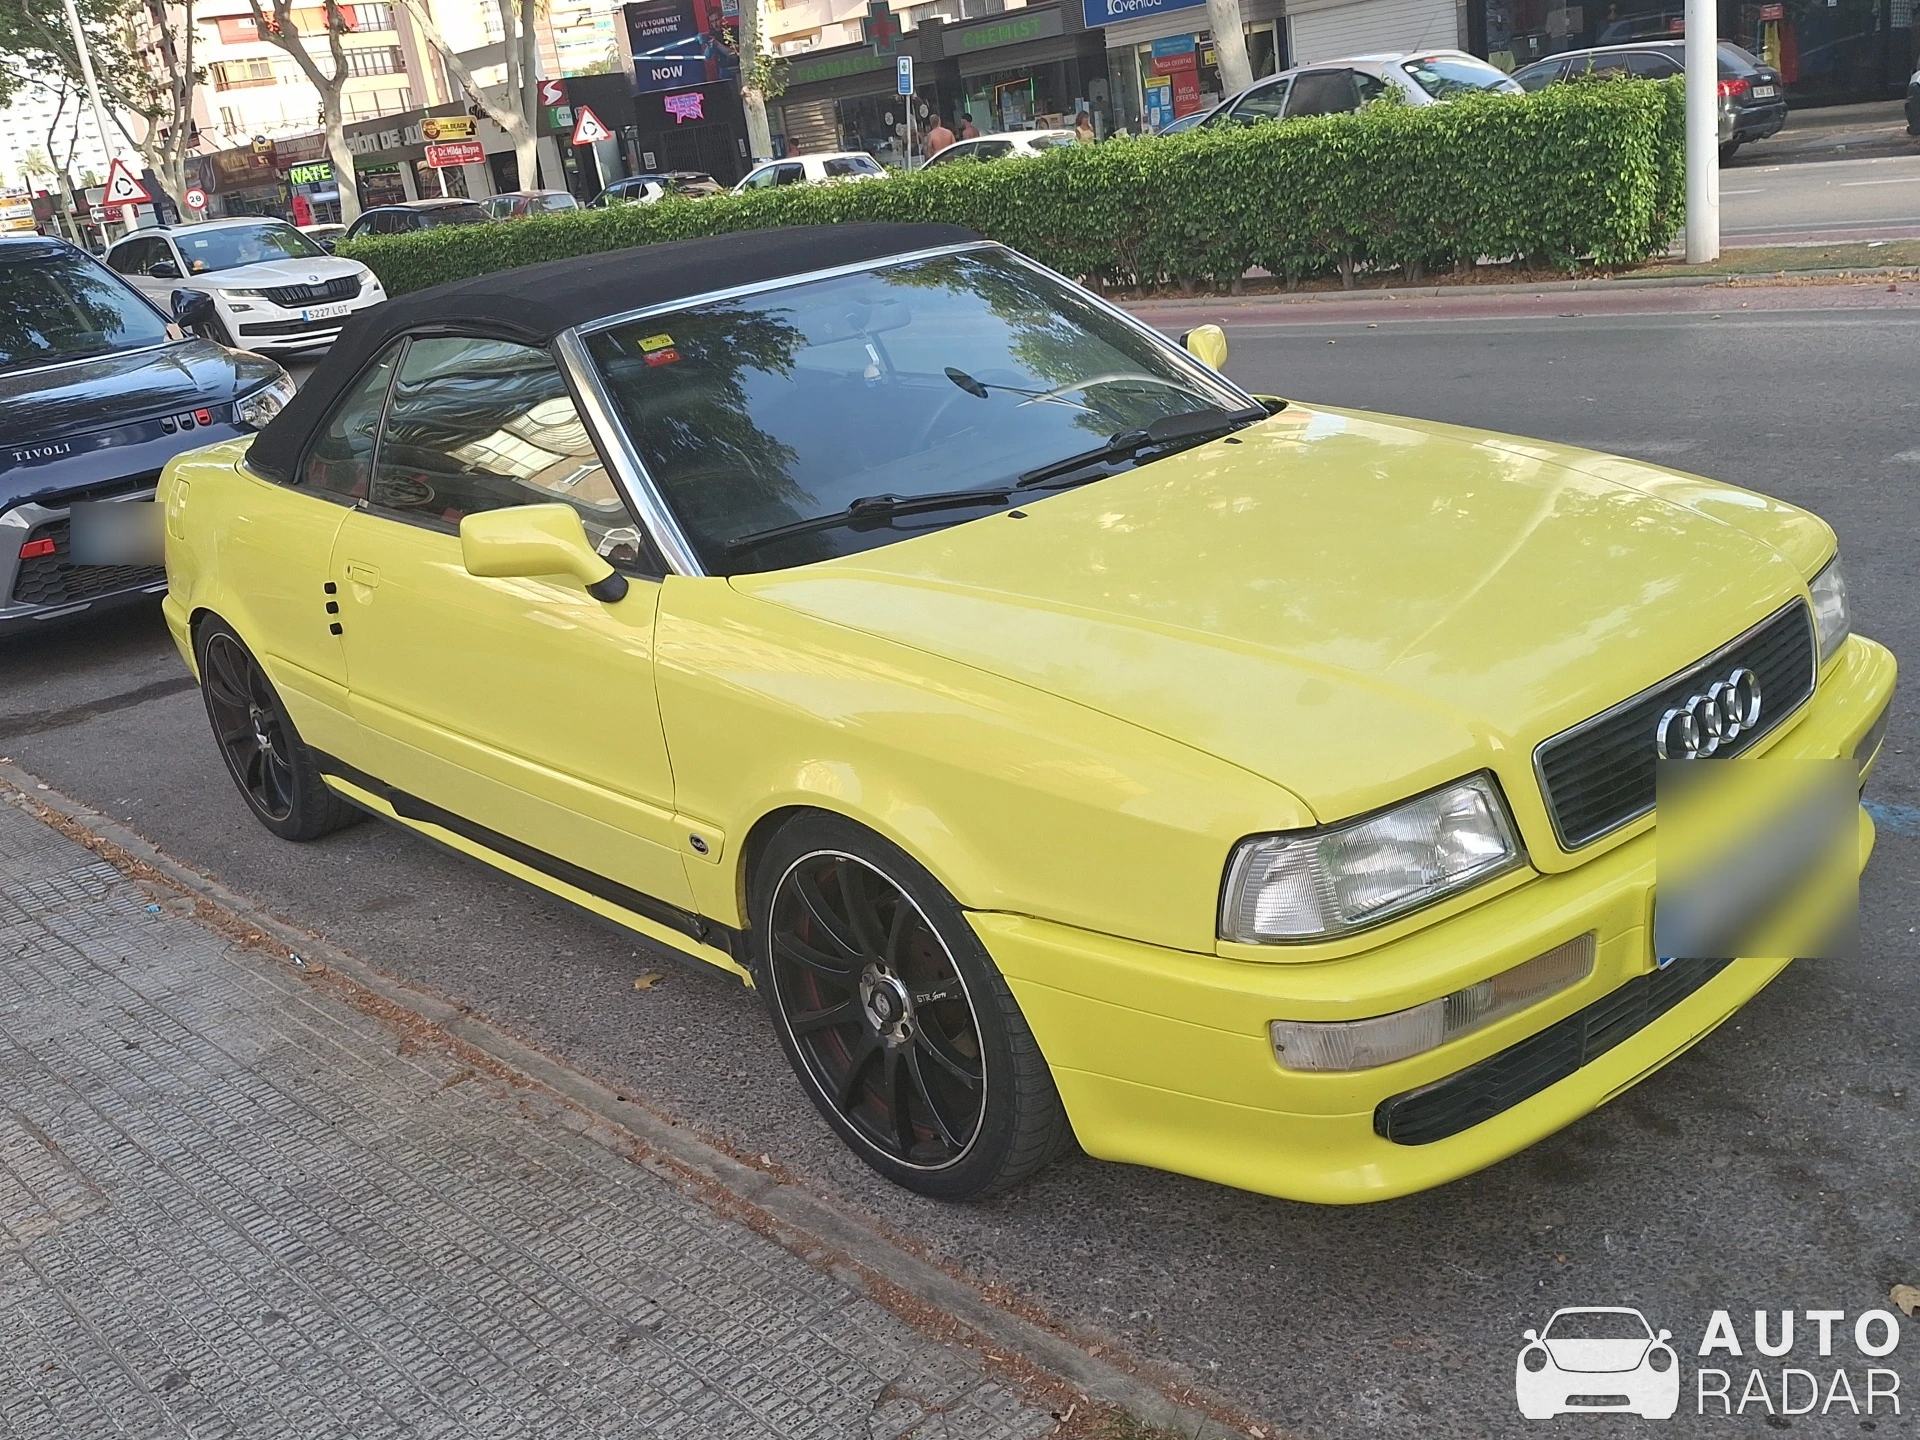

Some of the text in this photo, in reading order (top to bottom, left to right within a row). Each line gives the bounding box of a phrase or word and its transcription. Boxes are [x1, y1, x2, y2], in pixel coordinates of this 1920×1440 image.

[666, 14, 682, 23] NEXT
[642, 24, 678, 36] ADVENTURE
[962, 20, 1041, 47] CHEMIST
[1171, 57, 1192, 67] OFERTAS
[652, 65, 683, 80] NOW
[797, 56, 883, 82] FARMACIA
[1178, 86, 1195, 94] MEGA
[1175, 92, 1199, 102] OFERTAS
[380, 128, 399, 149] DE
[291, 163, 332, 184] NATE
[333, 305, 348, 315] LGT
[13, 443, 71, 462] TIVOLI
